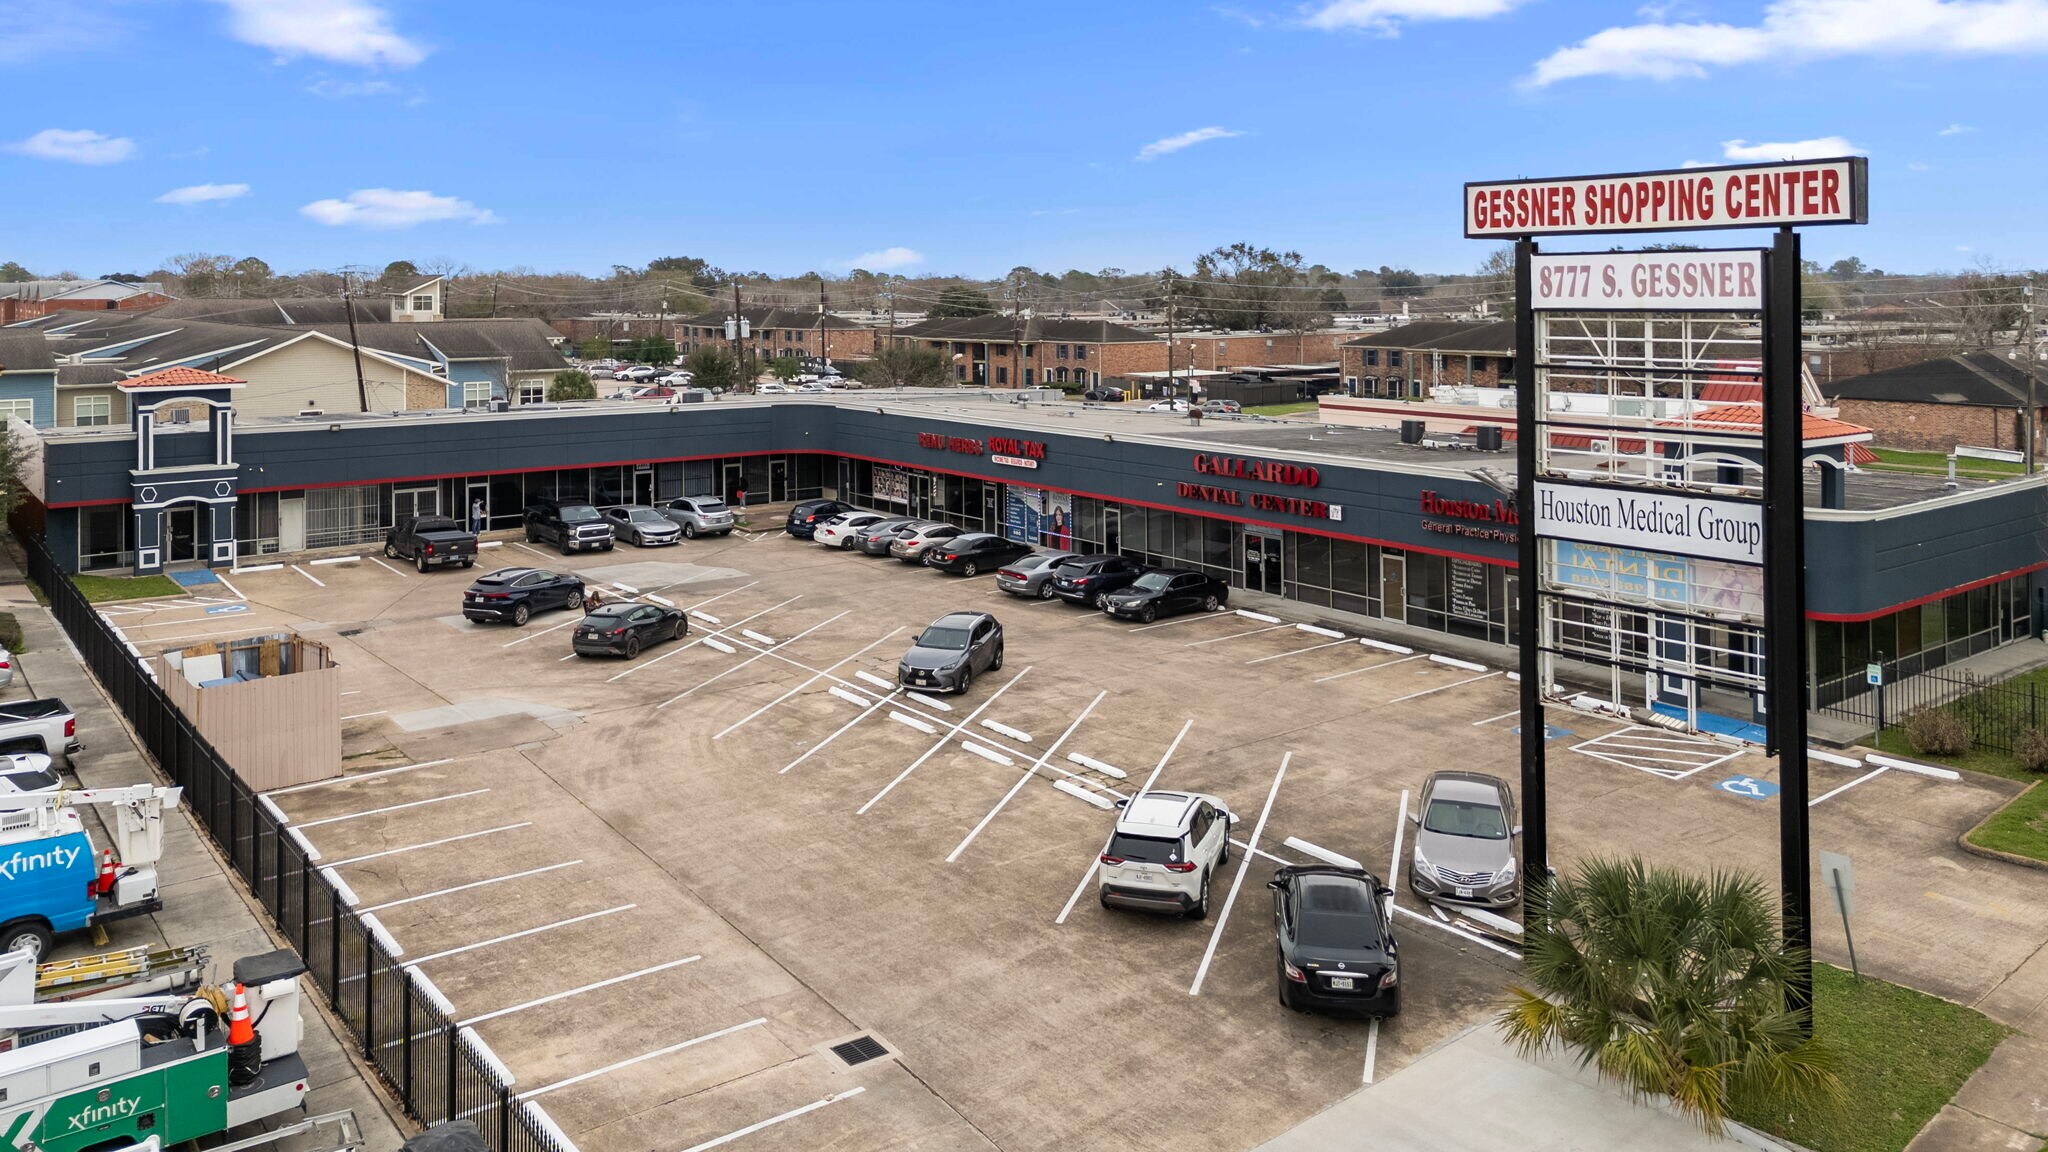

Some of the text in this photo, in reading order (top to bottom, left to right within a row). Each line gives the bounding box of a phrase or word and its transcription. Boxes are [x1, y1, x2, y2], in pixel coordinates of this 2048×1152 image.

[1474, 169, 1840, 229] GESSNER SHOPPING CENTER
[1540, 262, 1756, 298] 8777 S. GESSNER
[988, 436, 1044, 458] ROYAL TAX
[1193, 453, 1320, 488] GALLARDO
[1176, 482, 1329, 518] DENTAL CENTER
[1421, 489, 1491, 520] Houston
[1421, 519, 1453, 533] General
[1455, 524, 1489, 539] Practice
[1540, 489, 1761, 554] Houston Medical Group
[0, 846, 80, 880] xfinity
[68, 1096, 141, 1130] xfinity
